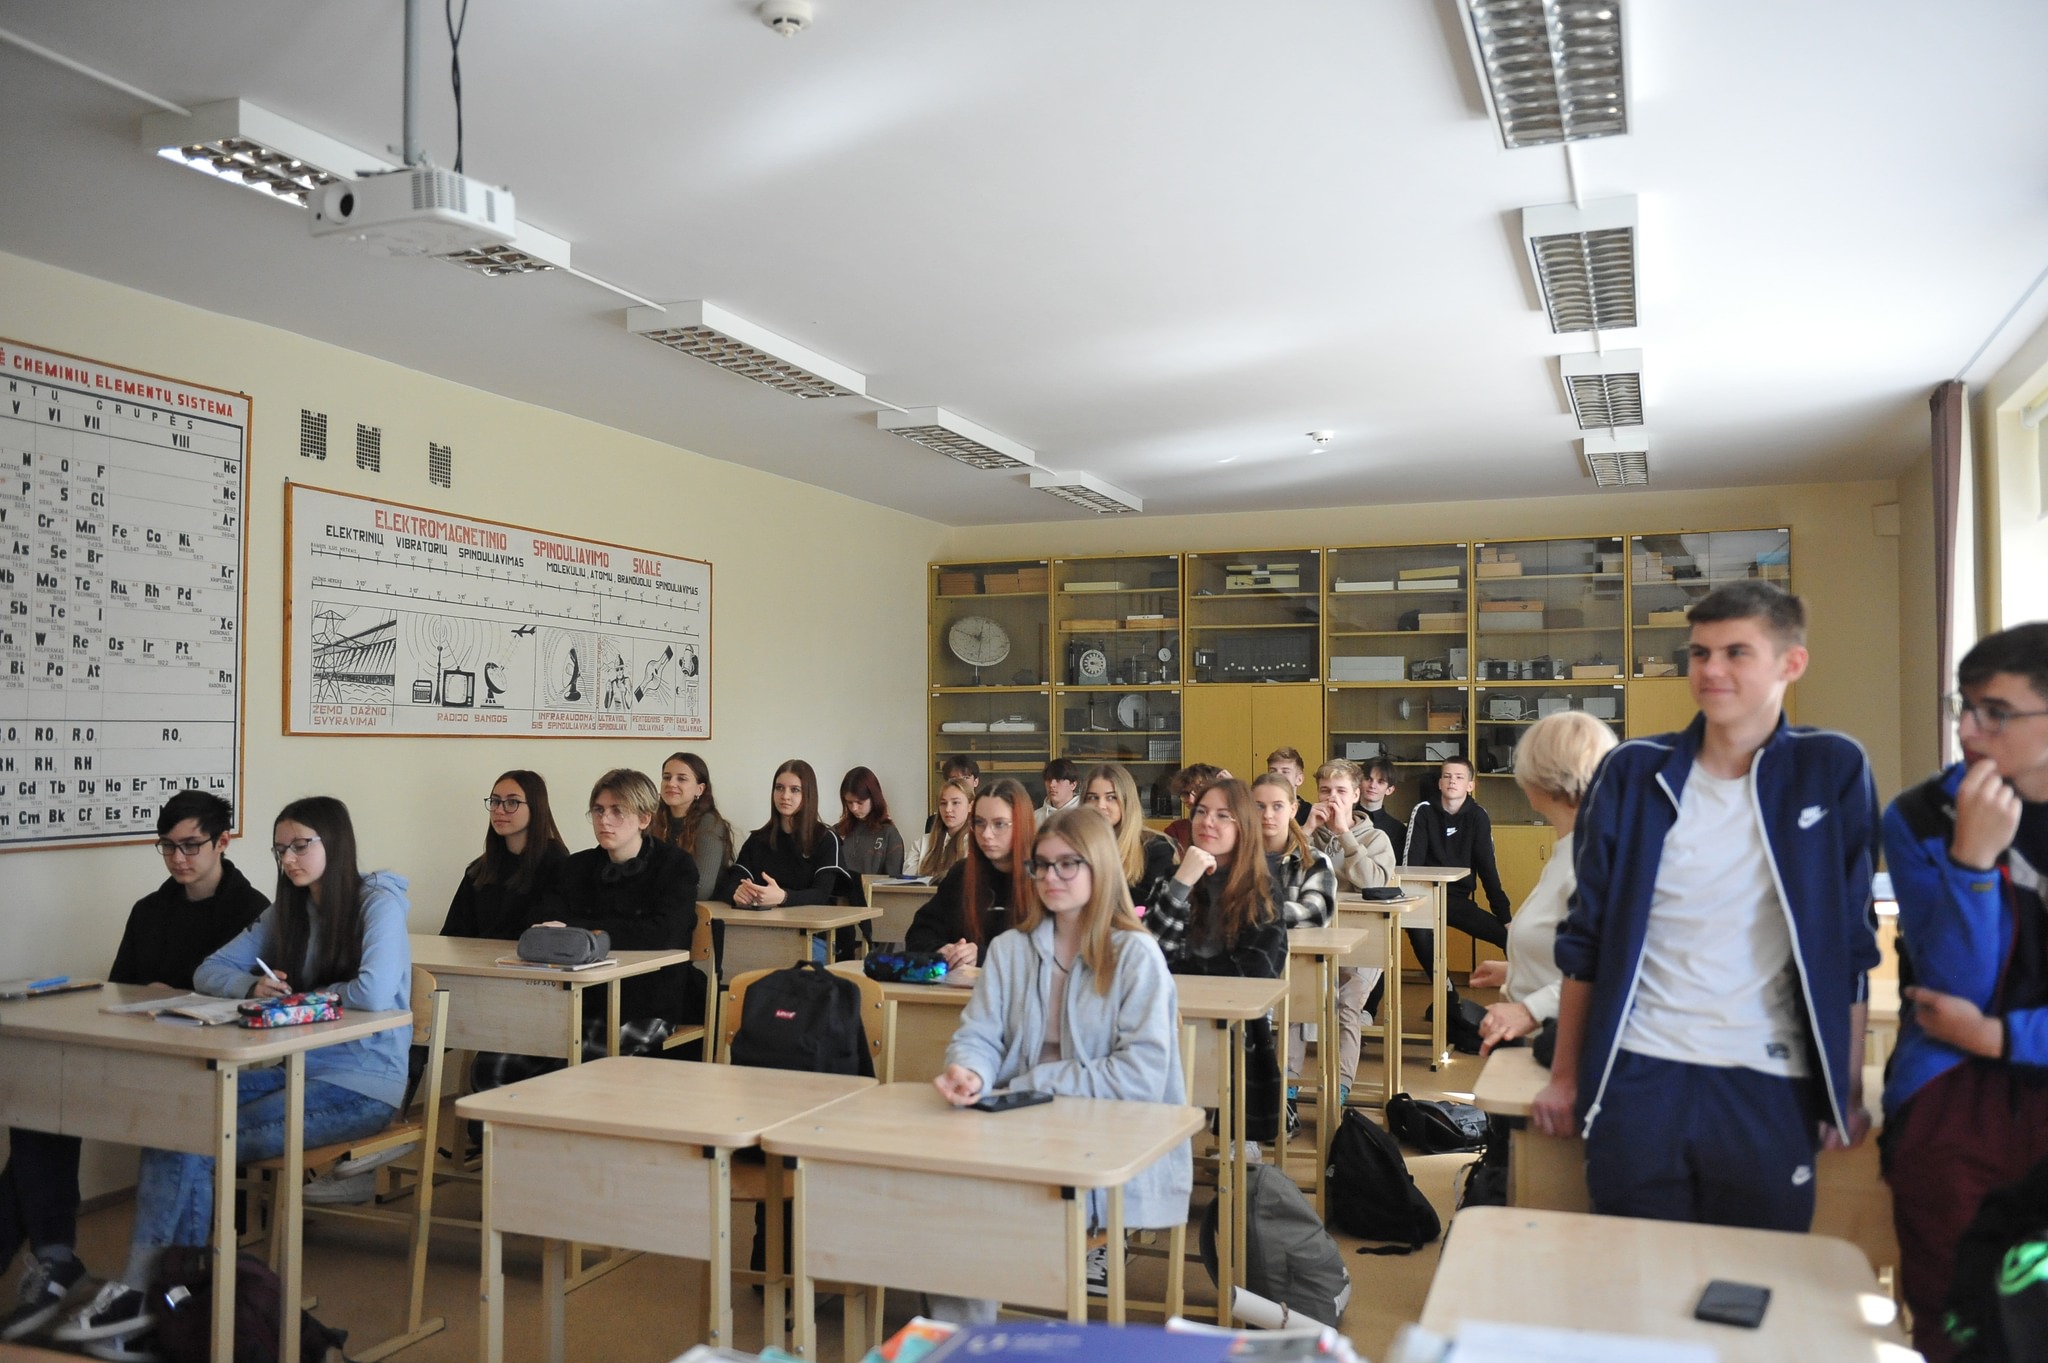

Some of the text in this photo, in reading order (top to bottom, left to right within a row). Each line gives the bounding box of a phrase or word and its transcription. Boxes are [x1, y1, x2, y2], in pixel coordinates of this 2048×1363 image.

[177, 394, 233, 417] SISTEMA
[12, 400, 190, 448] V VI VII VIII
[22, 452, 31, 467] N
[97, 465, 105, 478] F
[223, 460, 237, 474] He
[22, 481, 31, 495] P
[60, 487, 68, 502] S
[223, 487, 236, 500] Ne
[38, 514, 55, 528] Cr
[76, 519, 96, 534] Mn
[112, 524, 127, 538] Fe
[146, 529, 161, 543] Co
[179, 533, 190, 547] Ni
[222, 513, 235, 526] Ar
[375, 509, 507, 551] ELEKTROMAGNETINIO
[533, 539, 610, 568] SPINDULIAVIMO
[13, 541, 234, 579] As Se Br Kr
[458, 547, 524, 568] SPINDULIAVIMAS
[36, 572, 58, 588] Mo
[75, 576, 91, 591] Tc
[110, 580, 128, 595] Ru
[145, 583, 160, 598] Rh
[177, 587, 192, 601] Pd
[656, 580, 699, 595] SPINDULIAVIMAS
[10, 600, 28, 615] Sb
[49, 604, 66, 618] Te
[220, 617, 233, 630] Xe
[35, 632, 47, 646] W
[73, 634, 89, 649] Re
[109, 637, 124, 651] Os
[176, 641, 189, 655] Pt
[10, 660, 232, 683] Bi Po At Rn
[314, 716, 377, 726] SVYRAVIMAI
[437, 713, 508, 723] RADIJO BANGOS
[74, 756, 92, 770] RH
[49, 780, 66, 794] Tb
[78, 779, 95, 795] Dy
[105, 778, 121, 792] Ho
[132, 778, 148, 791] Er
[160, 777, 178, 790] Tm
[185, 777, 199, 790] Yb
[210, 776, 225, 788] Lu
[19, 810, 40, 825] Cm
[49, 809, 66, 823] Bk
[78, 807, 93, 822] Cf
[105, 806, 121, 820] Es
[132, 805, 152, 819] Fm
[874, 837, 883, 850] 5
